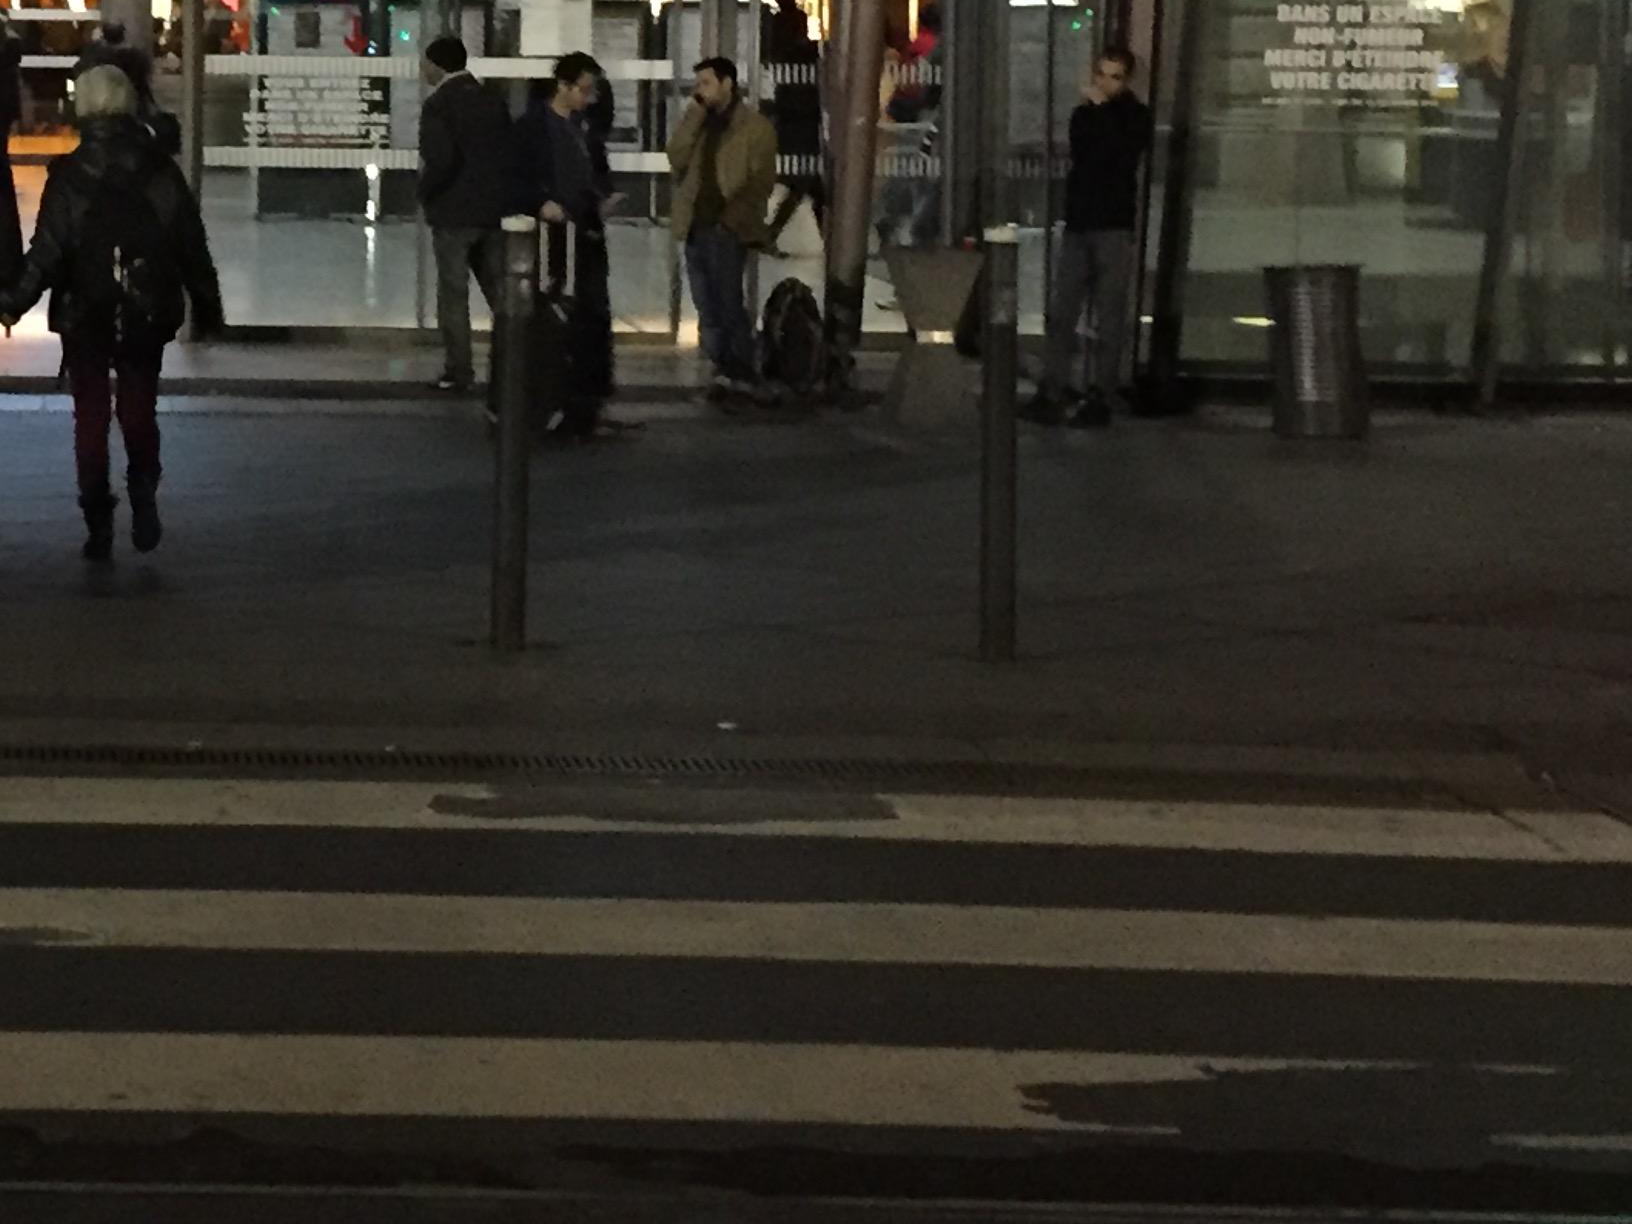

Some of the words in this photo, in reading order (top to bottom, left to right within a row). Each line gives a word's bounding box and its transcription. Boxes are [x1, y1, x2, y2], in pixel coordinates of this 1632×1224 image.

[1277, 4, 1330, 22] DANS
[1336, 5, 1363, 23] UN
[1264, 49, 1326, 67] MERCI
[1270, 72, 1331, 90] VOTRE
